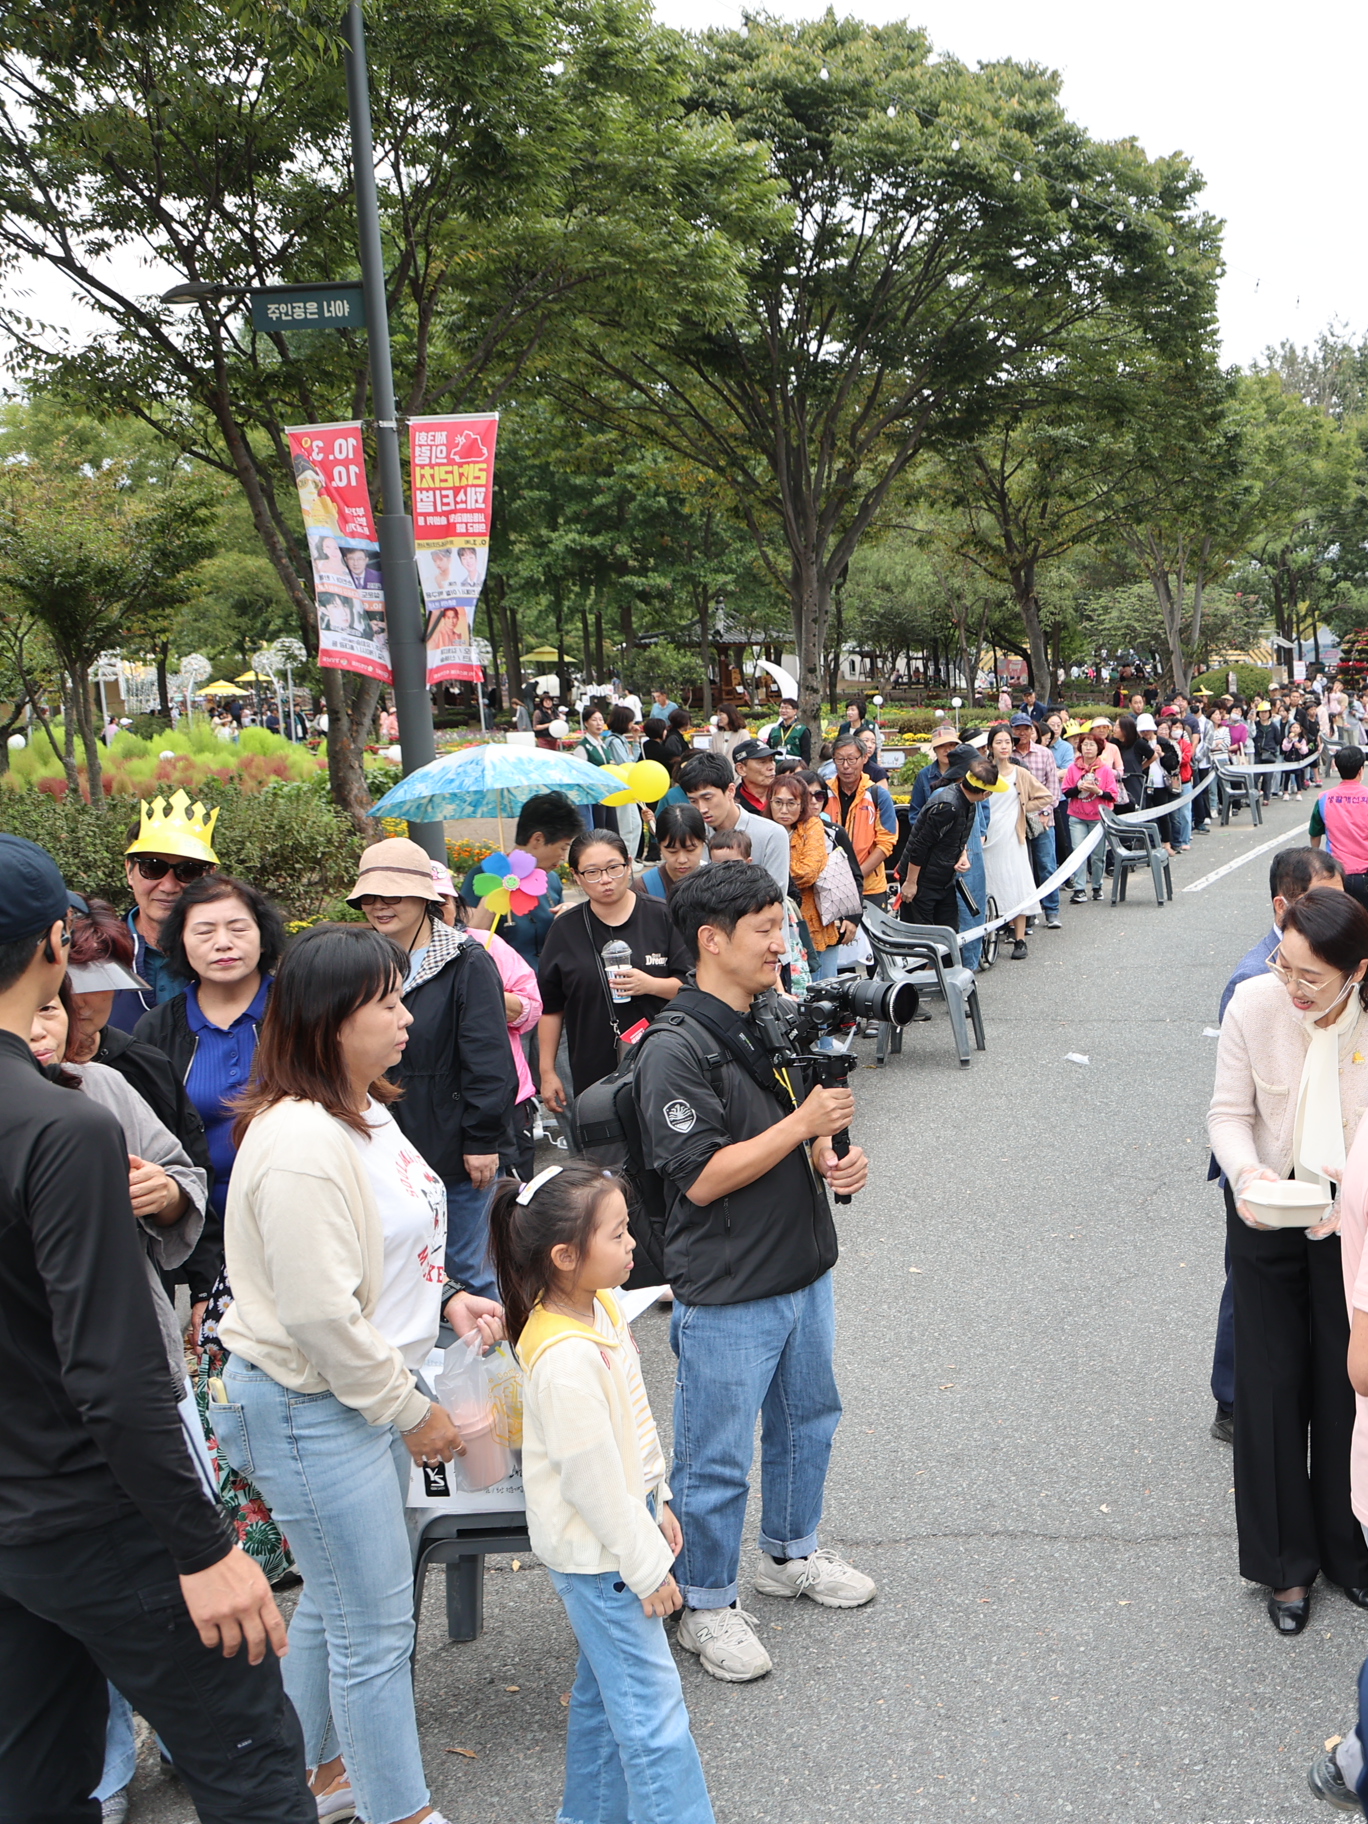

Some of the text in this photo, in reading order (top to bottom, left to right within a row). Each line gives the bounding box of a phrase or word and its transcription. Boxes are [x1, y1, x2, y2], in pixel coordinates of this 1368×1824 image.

[267, 300, 350, 321] 주인공은 너야
[1328, 795, 1368, 804] 생활개선회
